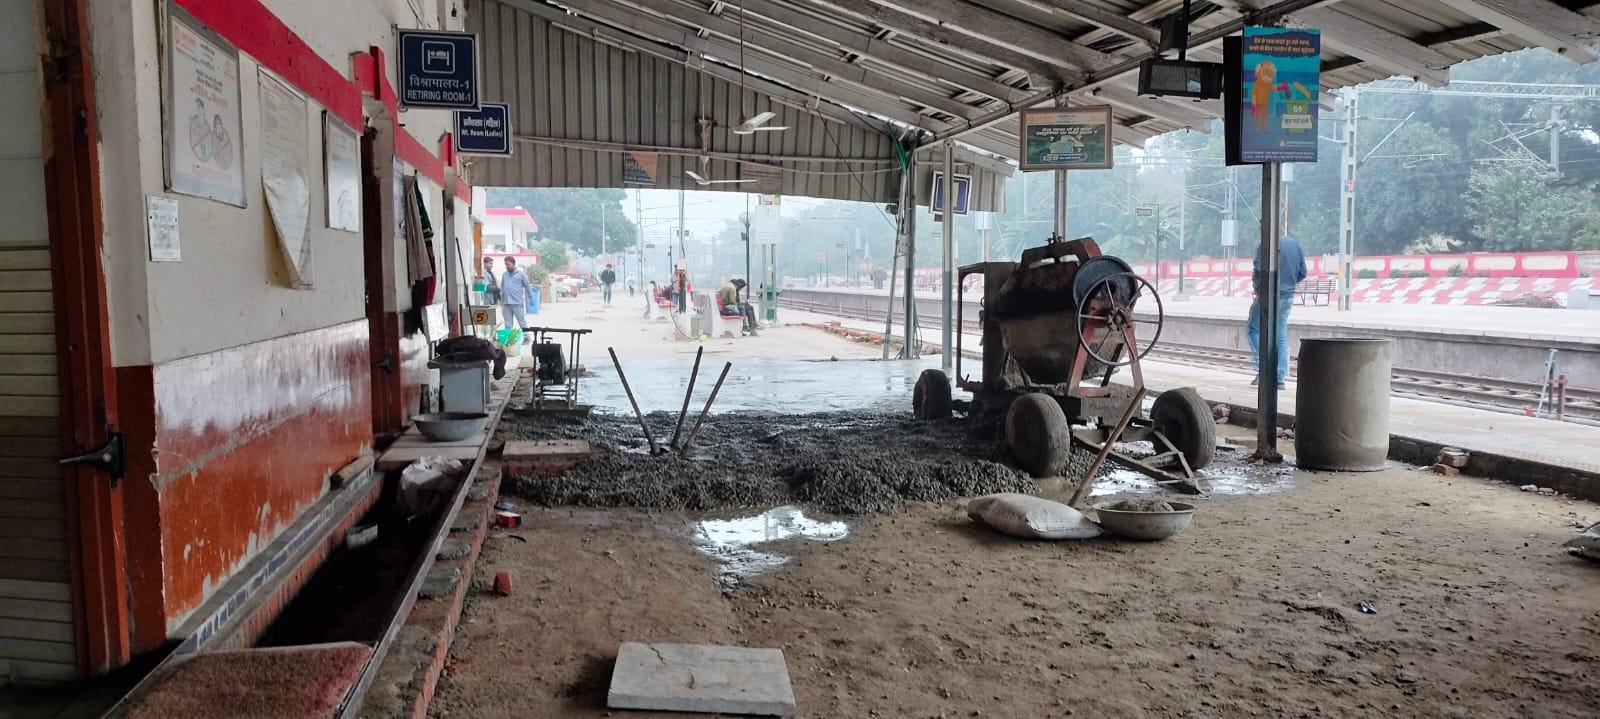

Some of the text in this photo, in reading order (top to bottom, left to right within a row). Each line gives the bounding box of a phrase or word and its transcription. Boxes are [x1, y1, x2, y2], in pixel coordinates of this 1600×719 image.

[409, 74, 469, 89] विश्रामालय-1
[407, 89, 471, 102] RETIRING ROOM-1
[477, 313, 484, 322] 5
